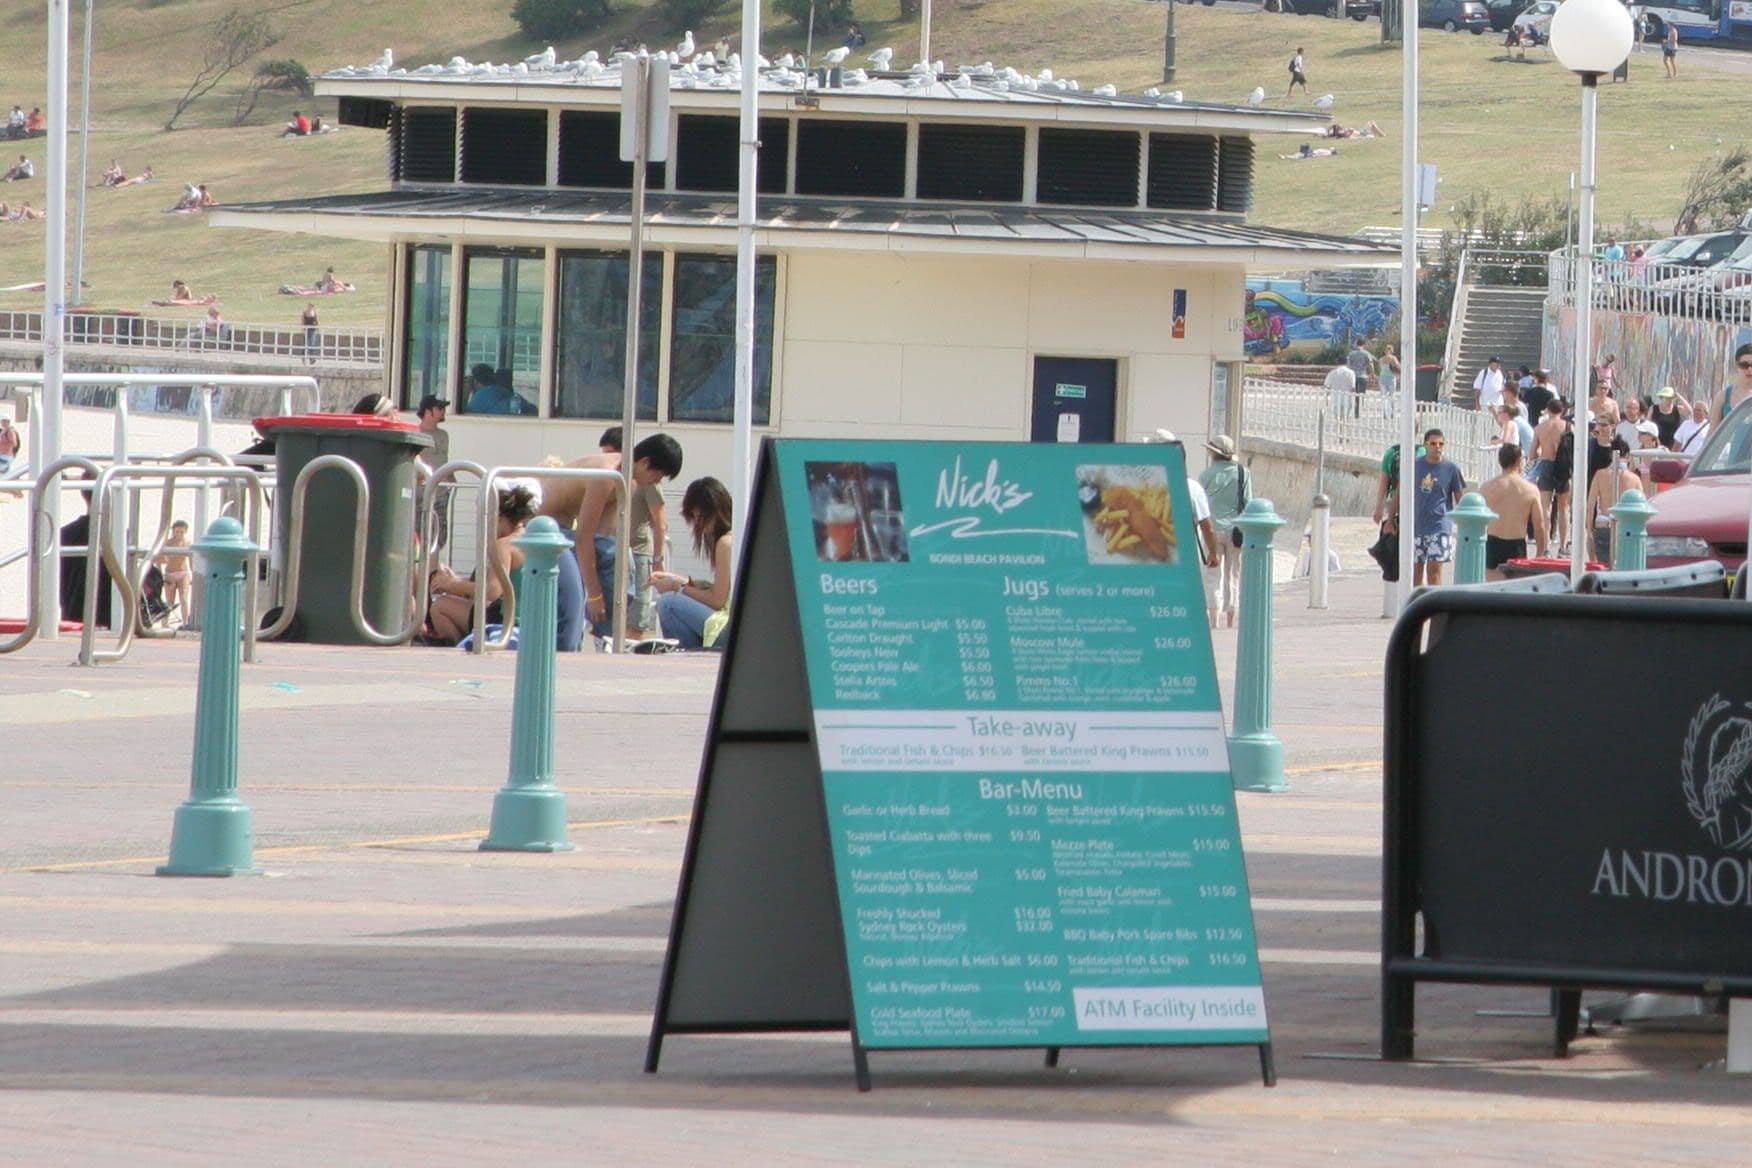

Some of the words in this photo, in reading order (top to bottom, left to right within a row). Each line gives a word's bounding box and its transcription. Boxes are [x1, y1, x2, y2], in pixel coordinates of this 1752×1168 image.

[936, 454, 1033, 514] Nick's
[930, 553, 962, 564] BONDI
[964, 553, 997, 564] BEACH
[999, 553, 1045, 564] PAVILION
[820, 573, 878, 594] Beers
[1003, 575, 1049, 600] Jugs
[1056, 584, 1093, 597] (serves
[1097, 584, 1104, 595] 2
[1107, 586, 1118, 595] or
[1122, 584, 1155, 597] more)
[823, 604, 847, 615] Beer
[850, 607, 863, 615] on
[867, 604, 885, 617] Tap
[1006, 605, 1033, 616] Cuba
[1036, 605, 1062, 616] Libre
[1150, 606, 1186, 618] $26.00
[826, 619, 867, 629] Cascade
[872, 619, 919, 629] Premium
[921, 619, 949, 632] Light
[955, 619, 985, 630] $5.00
[827, 633, 866, 643] Carlton
[869, 633, 914, 646] Draught
[957, 633, 987, 644] $5.50
[1010, 637, 1055, 647] Moscow
[1057, 637, 1085, 647] Mule
[1154, 637, 1191, 649] $26.00
[875, 647, 899, 657] New
[959, 647, 989, 659] $5.50
[831, 661, 875, 673] Coopers
[878, 661, 899, 671] Pale
[902, 661, 919, 671] Ale
[833, 675, 862, 685] Stella
[1015, 676, 1051, 686] Pimms
[1160, 676, 1197, 688] $26.00
[967, 716, 1077, 742] Take-away
[840, 744, 899, 756] Traditional
[903, 744, 926, 756] Fish
[930, 745, 938, 756] &
[942, 744, 973, 758] Chips
[979, 745, 1012, 757] $16.50
[1022, 745, 1045, 756] Beer
[1051, 745, 1098, 756] Battered
[1101, 746, 1126, 759] King
[1130, 746, 1171, 757] Prawns
[979, 778, 1082, 799] Bar-Menu
[842, 804, 872, 816] Garlic
[876, 807, 887, 815] or
[891, 805, 915, 815] Herb
[919, 805, 949, 815] Bread
[1046, 805, 1069, 816] Beer
[1072, 805, 1117, 816] Battered
[1119, 805, 1144, 819] King
[1146, 806, 1184, 816] Prawns
[1188, 805, 1224, 817] $15.50
[847, 831, 887, 841] Toasted
[937, 831, 960, 841] with
[964, 831, 992, 841] three
[847, 843, 871, 856] Dips
[1088, 839, 1114, 850] Plate
[1193, 839, 1229, 851] $15.00
[851, 869, 906, 880] Marinated
[947, 869, 978, 880] Sliced
[1015, 869, 1046, 880] $5.00
[854, 882, 912, 895] Sourdough
[915, 883, 923, 892] &
[1057, 886, 1083, 897] Fried
[1086, 886, 1111, 900] Baby
[1199, 885, 1236, 897] $15.00
[857, 907, 892, 920] Freshly
[896, 907, 940, 918] Shucked
[859, 921, 896, 934] Sydney
[899, 921, 925, 931] Rock
[928, 921, 966, 934] Oysters
[1063, 929, 1086, 940] BBQ
[1088, 929, 1115, 942] Baby
[1118, 929, 1139, 939] Pork
[1143, 929, 1173, 941] Spare
[1176, 929, 1197, 940] Ribs
[1206, 928, 1242, 940] $12.50
[863, 955, 893, 967] Chips
[894, 955, 918, 965] with
[922, 955, 959, 966] Lemon
[962, 955, 970, 966] &
[973, 955, 998, 966] Herb
[1001, 955, 1021, 966] Salt
[1028, 955, 1058, 967] $6.00
[1068, 955, 1122, 965] Traditional
[1125, 955, 1146, 965] Fish
[1150, 955, 1157, 965] &
[1160, 955, 1189, 967] Chips
[1209, 954, 1246, 966] $16.50
[867, 981, 884, 992] Salt
[889, 982, 897, 992] &
[901, 982, 938, 995] Pepper
[941, 982, 980, 992] Prawns
[871, 1007, 895, 1018] Cold
[899, 1007, 942, 1018] Seafood
[945, 1007, 971, 1018] Plate
[1084, 1000, 1125, 1017] ATM
[1133, 998, 1196, 1021] Facility
[1202, 997, 1257, 1017] Inside
